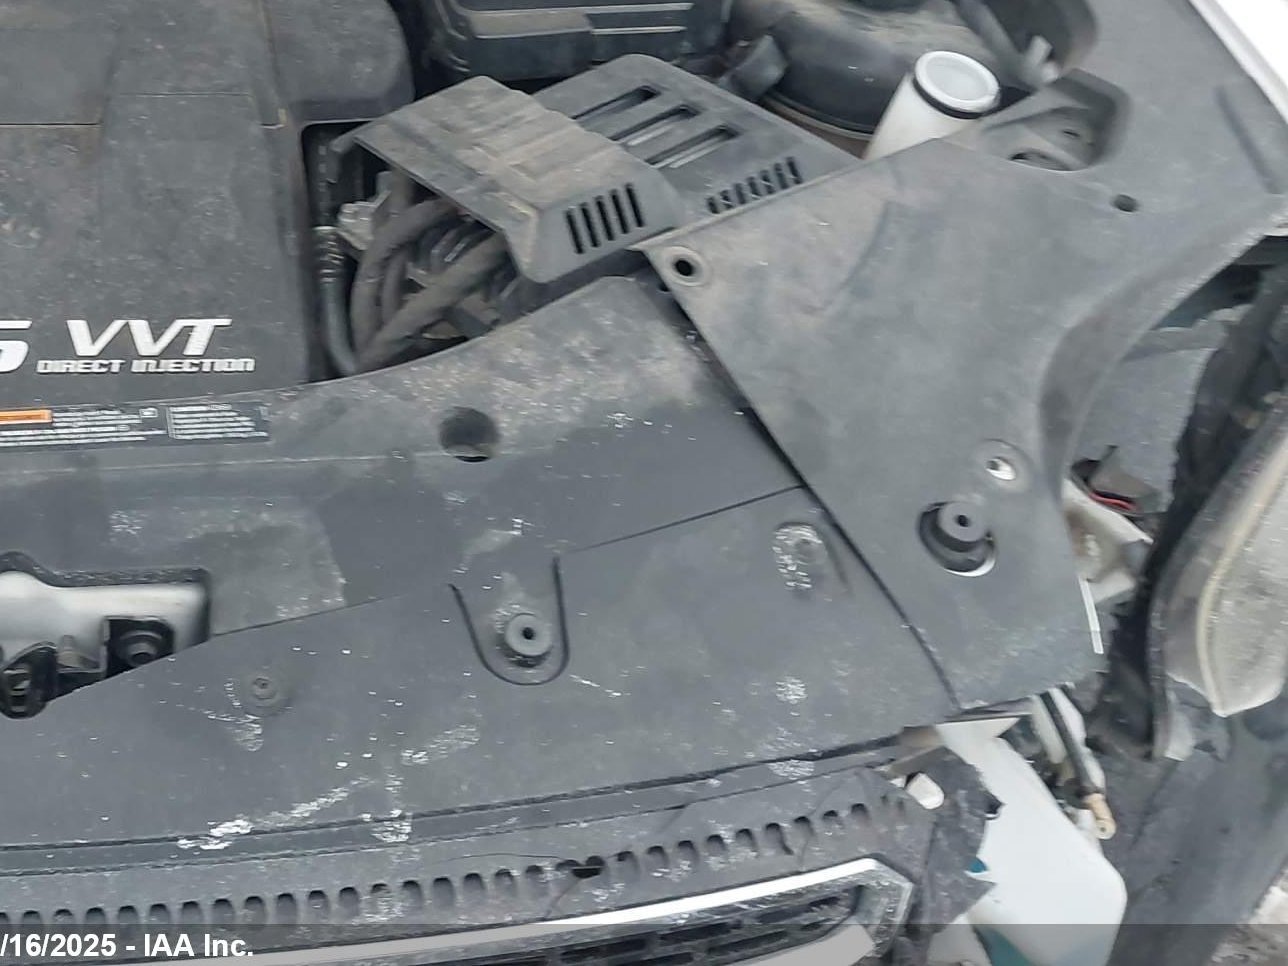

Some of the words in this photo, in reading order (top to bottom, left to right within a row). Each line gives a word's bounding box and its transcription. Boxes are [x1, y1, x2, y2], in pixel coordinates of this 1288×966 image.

[66, 318, 233, 357] VVT
[36, 359, 126, 374] DIRECT
[130, 358, 256, 373] INJECTION
